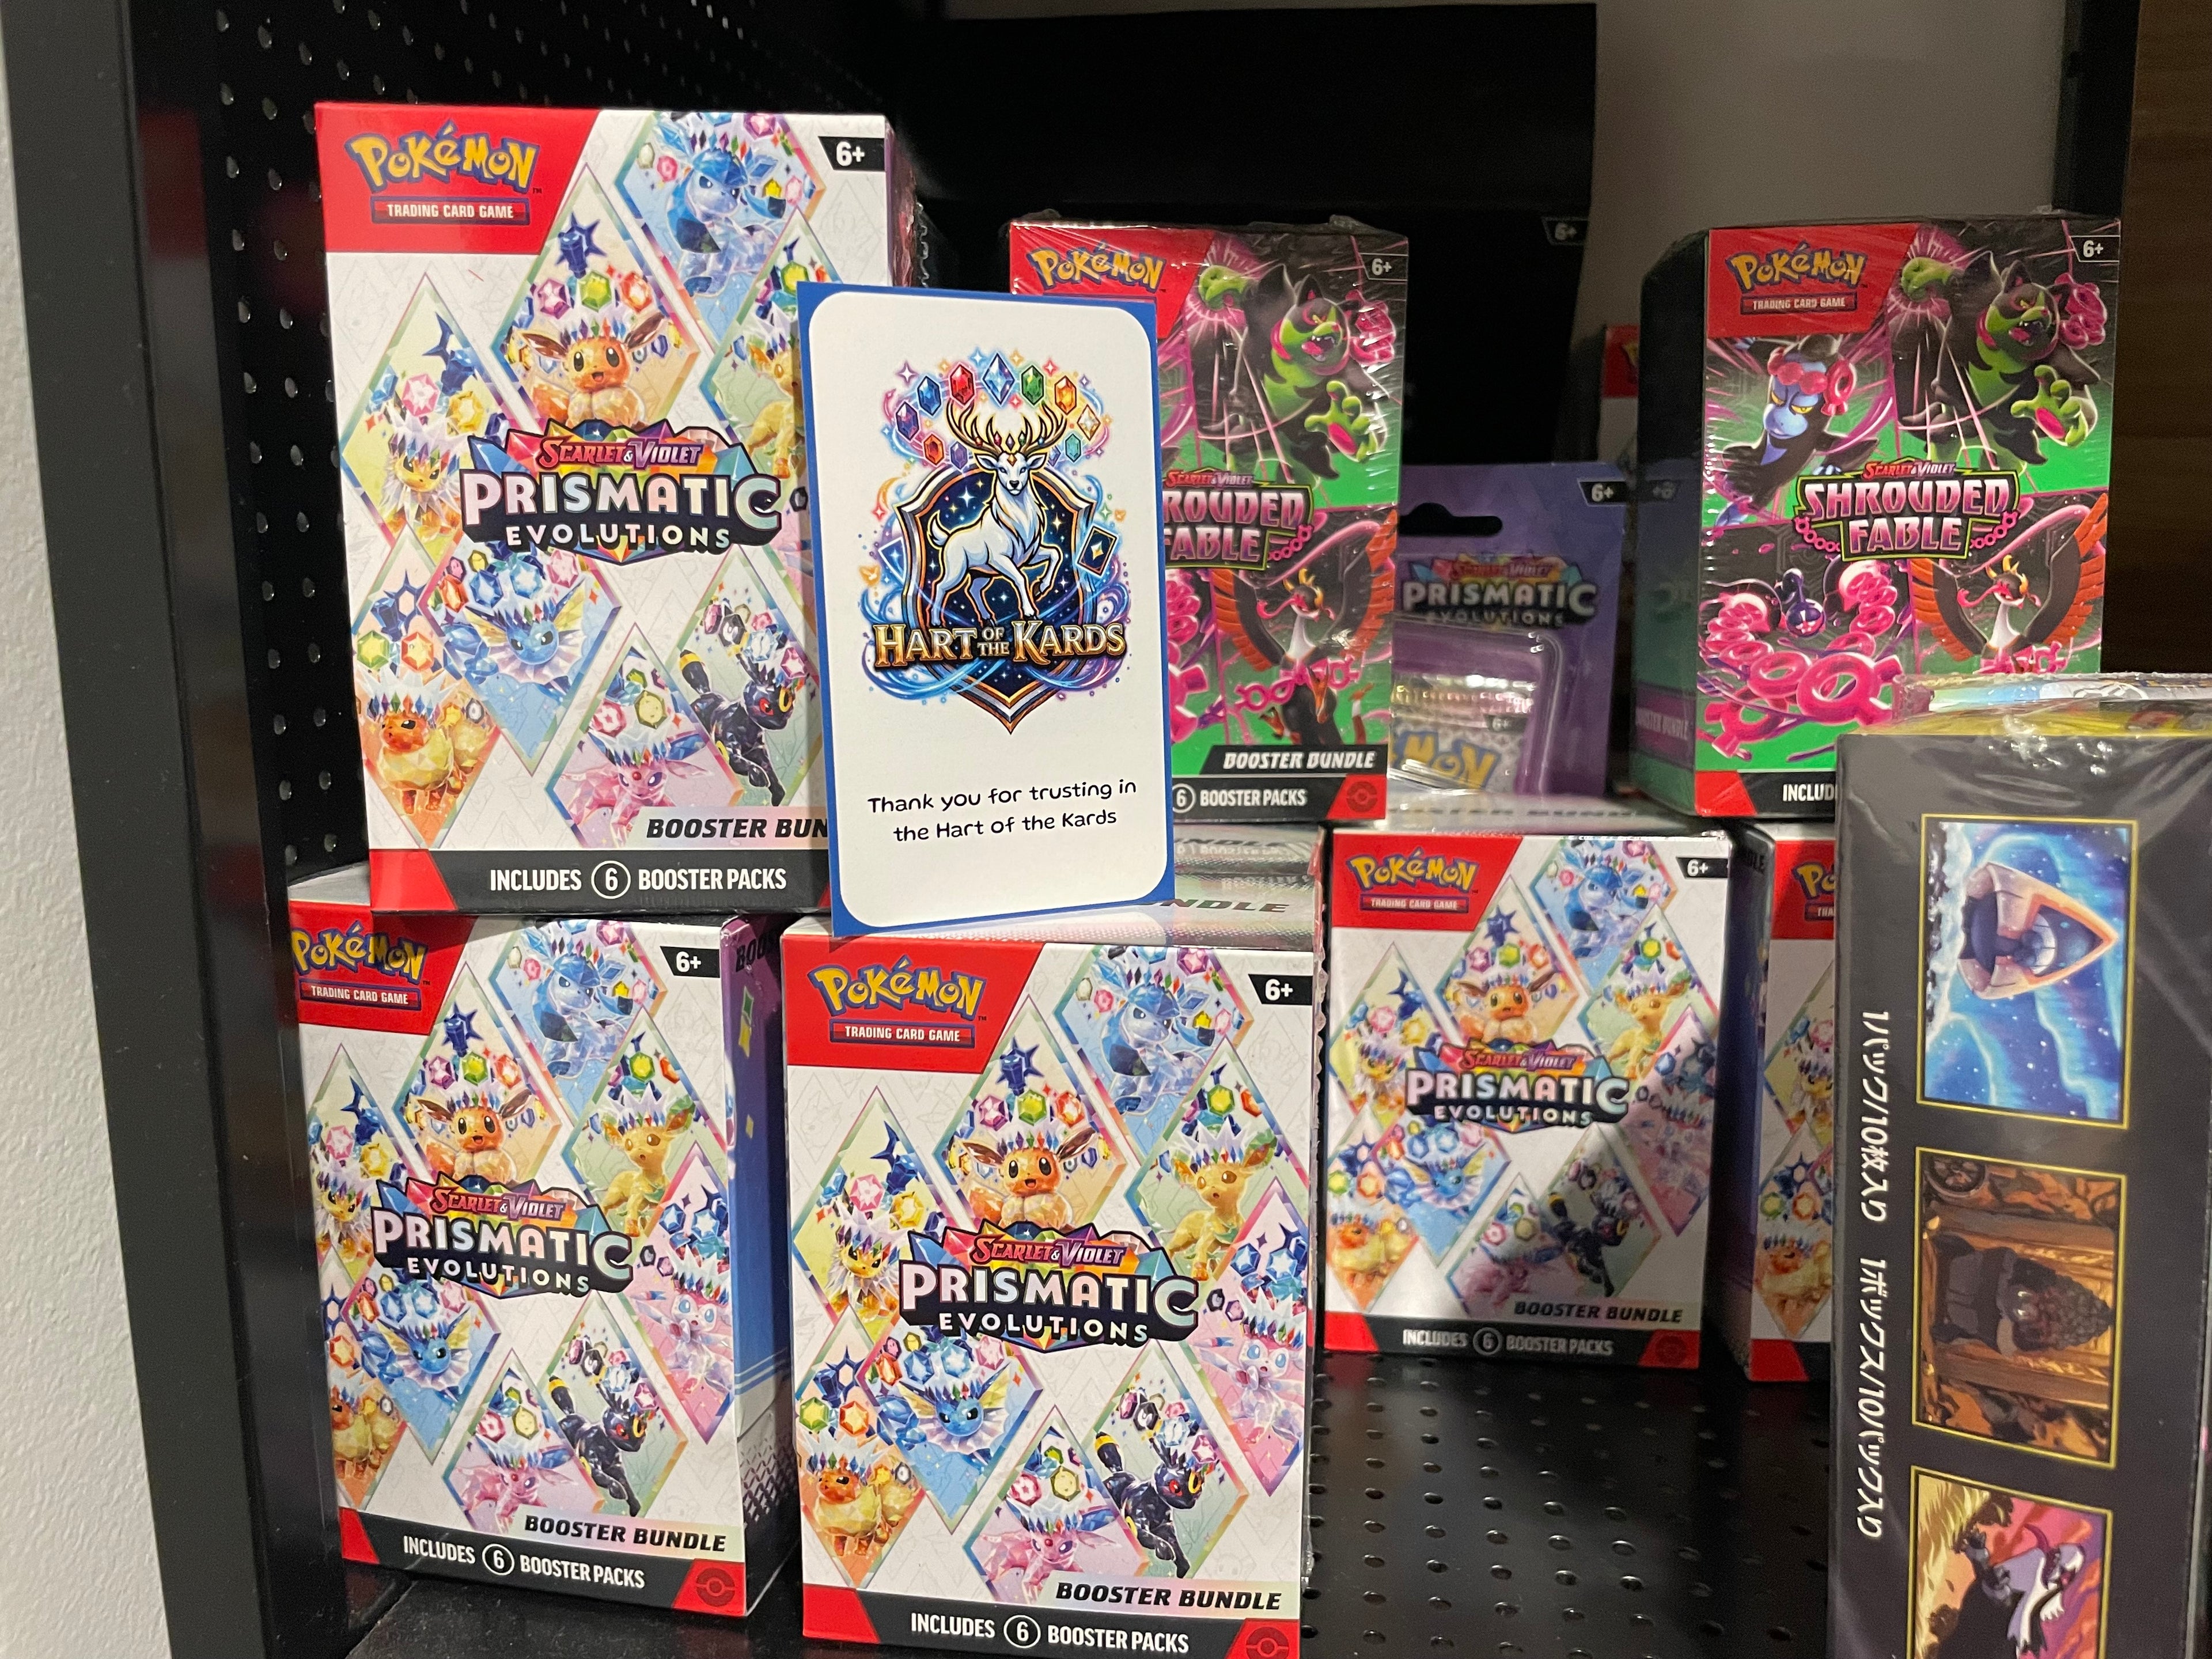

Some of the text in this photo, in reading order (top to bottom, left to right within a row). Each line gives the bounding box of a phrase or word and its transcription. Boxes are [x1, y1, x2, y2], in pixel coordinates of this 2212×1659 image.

[836, 141, 865, 167] 6+
[387, 204, 514, 219] TRADING CARD GAME
[2082, 240, 2104, 258] 6+
[1372, 258, 1392, 275] 6+
[1752, 297, 1846, 310] TRADING CARD GAME
[461, 469, 781, 531] PRISMATIC
[1591, 483, 1614, 502] 6+
[1804, 478, 2009, 522] SHROUDED
[1162, 490, 1305, 529] ROUDED
[506, 523, 730, 547] EVOLUTIONS
[1849, 517, 1962, 554] FABLE
[1403, 581, 1597, 617] PRISMATIC
[873, 620, 1126, 667] HART OF THE KARDS
[1222, 751, 1377, 770] BOOSTER BUNDLE
[868, 779, 1137, 813] Thank you for trusting in
[1176, 788, 1308, 806] 6 BOOSTER PACKS
[1783, 783, 1838, 802] INCLUD
[646, 818, 828, 838] BOOSTER BUN
[893, 809, 1118, 842] the Hart of the Kards
[490, 868, 787, 891] INCLUDES 6 BOOSTER PACKS
[1687, 859, 1709, 877] 6+
[1160, 898, 1290, 913] NDLE
[1370, 897, 1458, 911] TRADING CARD GAME
[676, 950, 702, 972] 6+
[310, 985, 409, 1005] TRADING CARD GAME
[1265, 978, 1293, 1001] 6+
[844, 1025, 960, 1042] TRADING CARD GAME
[1406, 1069, 1629, 1115] PRISMATIC
[1434, 1104, 1593, 1126] EVOLUTIONS
[372, 1209, 633, 1281] PRISMATIC
[407, 1256, 590, 1294] EVOLUTIONS
[901, 1262, 1199, 1328] PRISMATIC
[1513, 1301, 1683, 1324] BOOSTER BUNDLE
[939, 1312, 1149, 1342] EVOLUTIONS
[1402, 1329, 1613, 1356] INCLUDES 6 BOOSTER PACKS
[524, 1514, 727, 1552] BOOSTER BUNDLE
[403, 1535, 645, 1589] INCLUDES 6 BOOSTER PACKS
[1055, 1581, 1282, 1611] BOOSTER BUNDLE
[911, 1613, 1189, 1654] INCLUDES 6 BOOSTER PACKS
